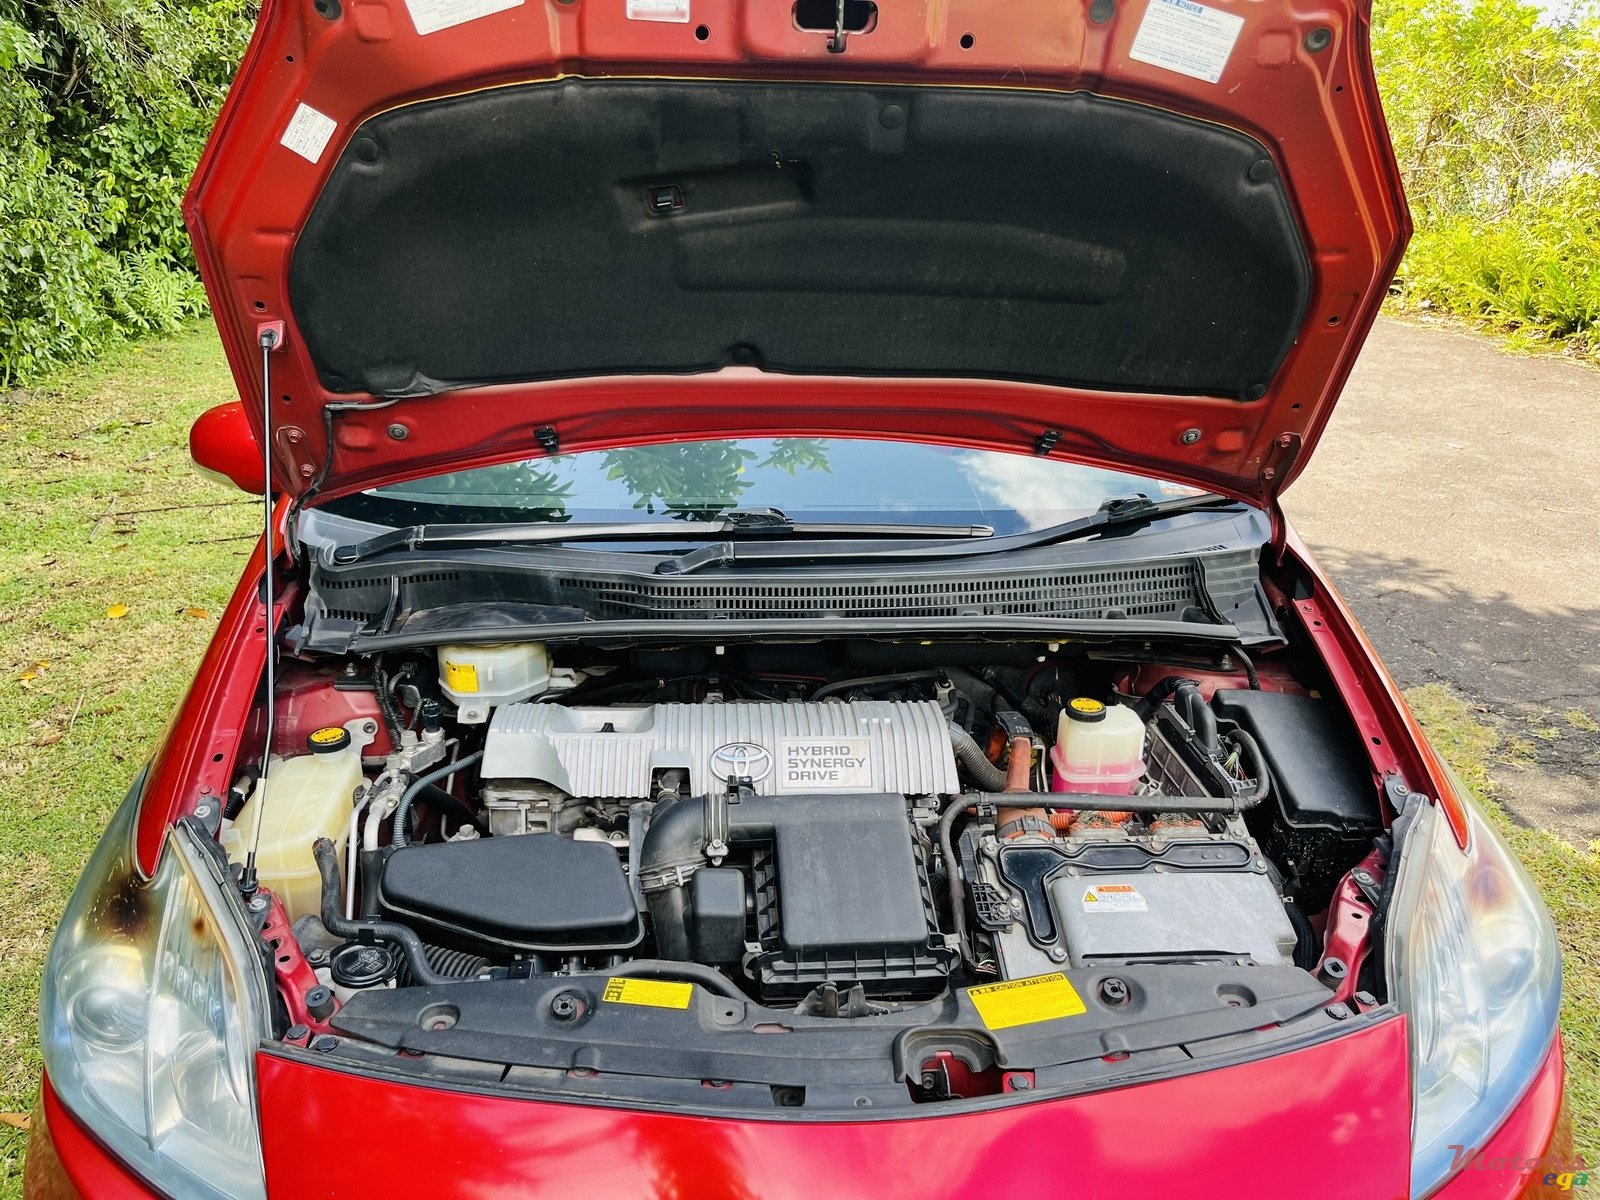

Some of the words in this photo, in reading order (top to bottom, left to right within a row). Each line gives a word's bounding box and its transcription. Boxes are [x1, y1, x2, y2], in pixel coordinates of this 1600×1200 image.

[787, 745, 851, 756] HYBRID
[787, 758, 867, 769] SYNERGY
[787, 771, 840, 781] DRIVE
[994, 981, 1024, 991] CAUTION
[1025, 974, 1063, 986] ATTENTION
